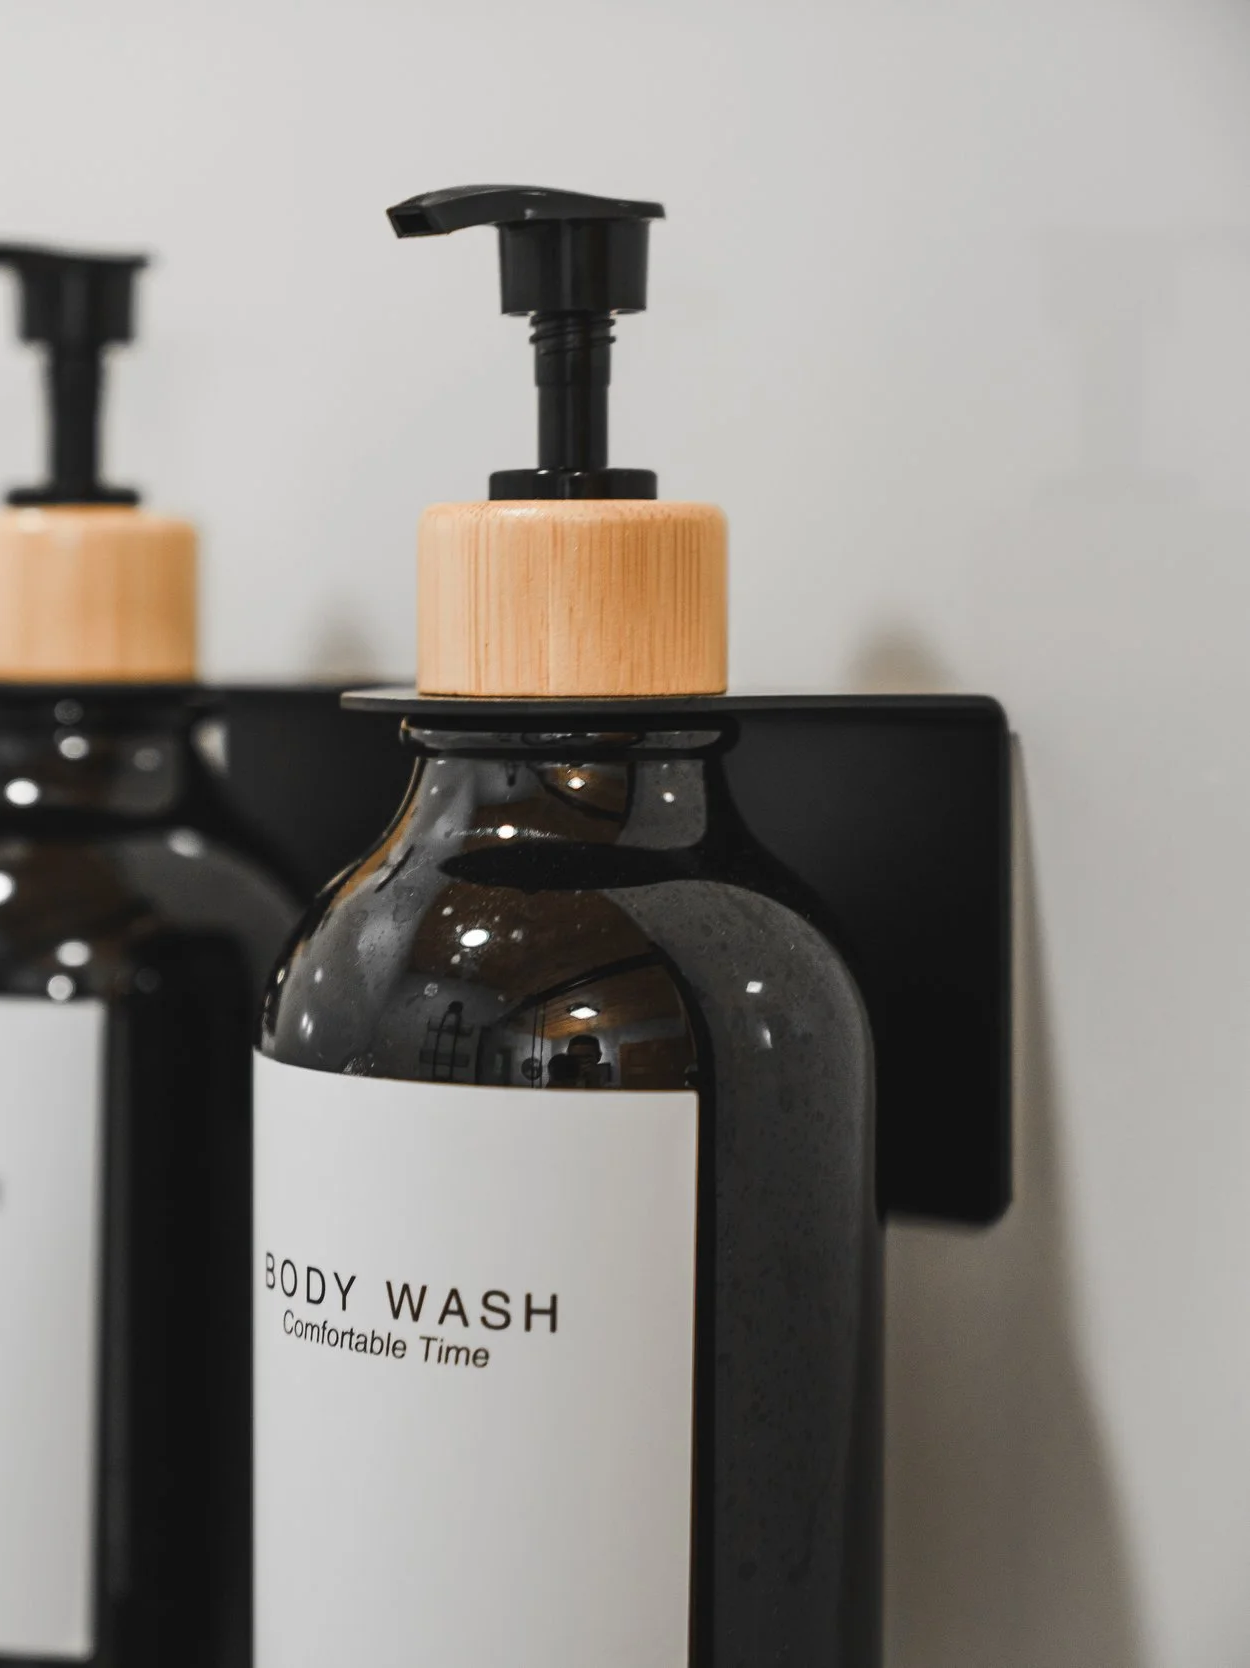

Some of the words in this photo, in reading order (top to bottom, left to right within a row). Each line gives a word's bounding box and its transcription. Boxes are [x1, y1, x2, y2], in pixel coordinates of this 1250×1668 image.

[265, 1252, 357, 1311] BODY
[385, 1280, 559, 1333] WASH
[283, 1309, 408, 1359] Comfortable
[419, 1335, 491, 1368] Time
